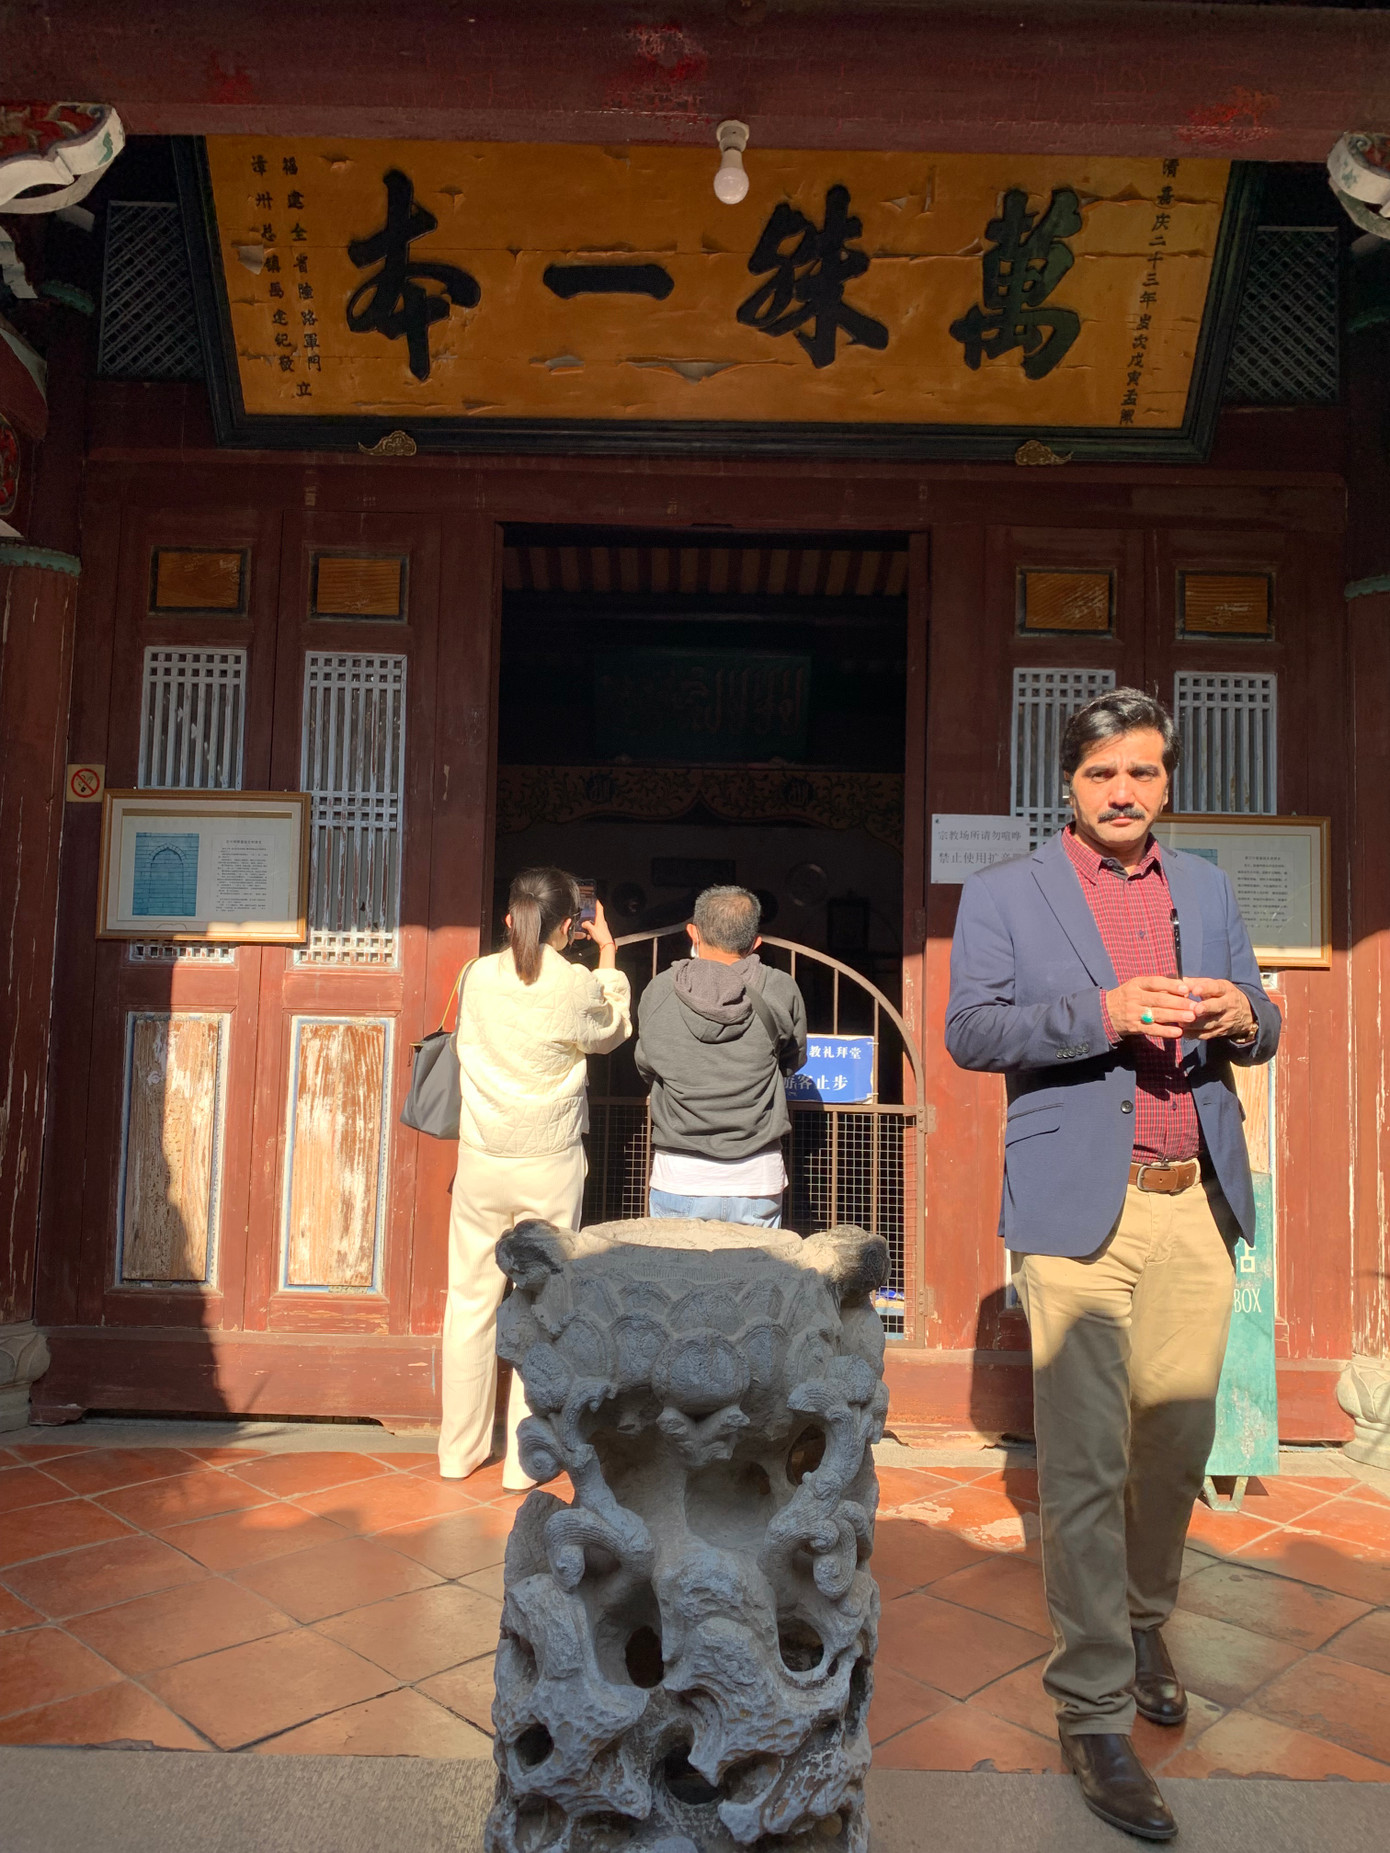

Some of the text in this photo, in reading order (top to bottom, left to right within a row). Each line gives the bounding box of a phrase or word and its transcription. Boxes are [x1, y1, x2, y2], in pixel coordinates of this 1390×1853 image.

[937, 830, 1022, 841] 宗教场所请勿喧哗
[938, 851, 1021, 865] 禁止使用扩
